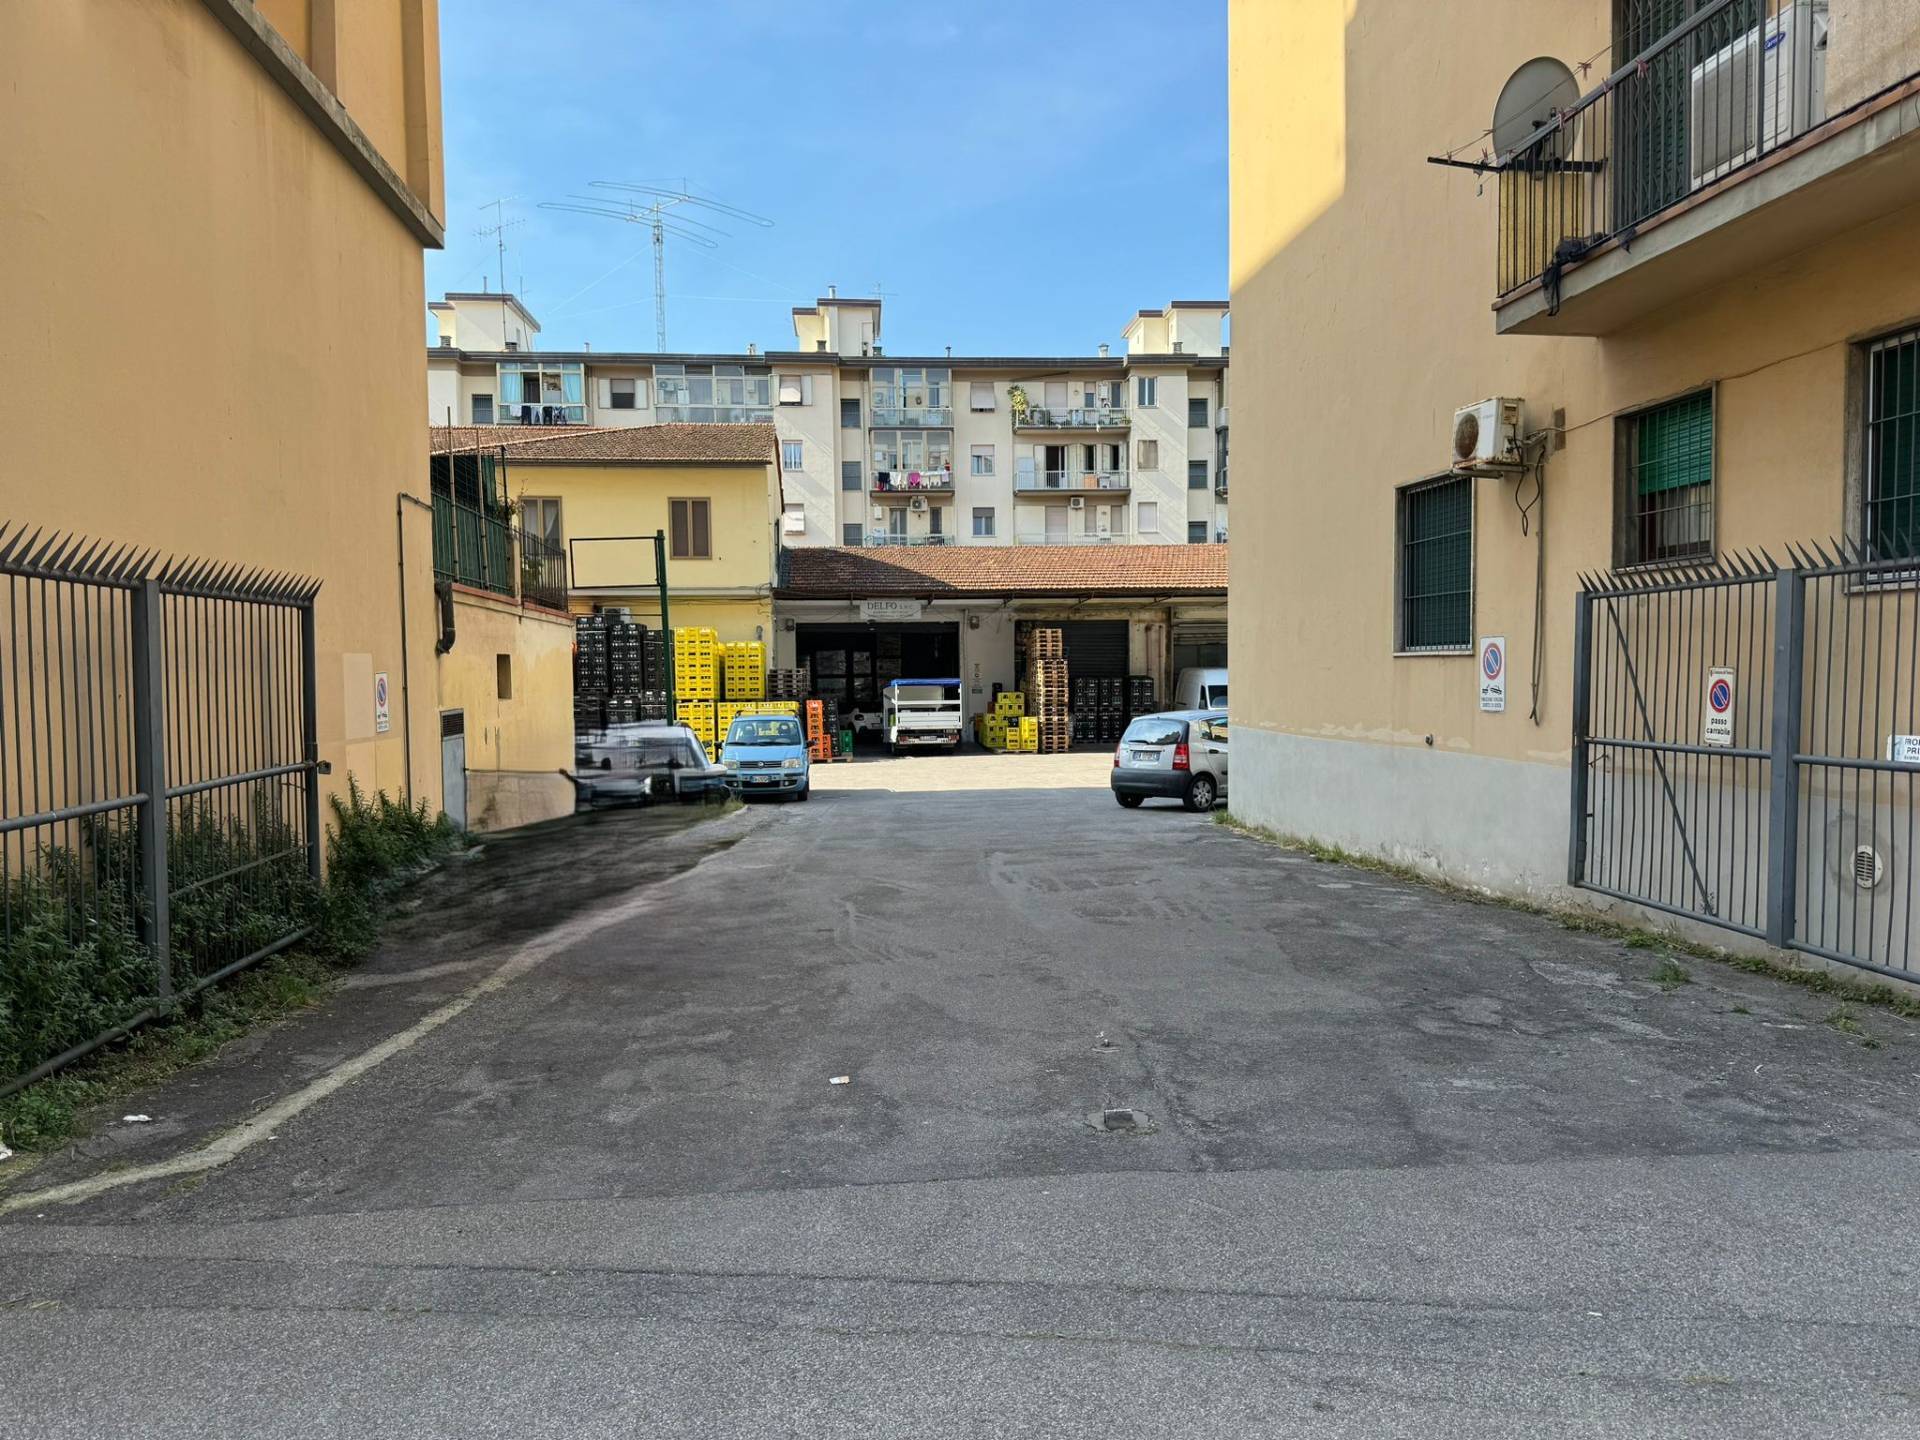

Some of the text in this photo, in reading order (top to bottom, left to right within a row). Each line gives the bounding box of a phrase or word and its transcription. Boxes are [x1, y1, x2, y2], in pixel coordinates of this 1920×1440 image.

[867, 601, 898, 610] DELFO
[1710, 717, 1728, 726] passo
[1706, 727, 1731, 736] carrabile
